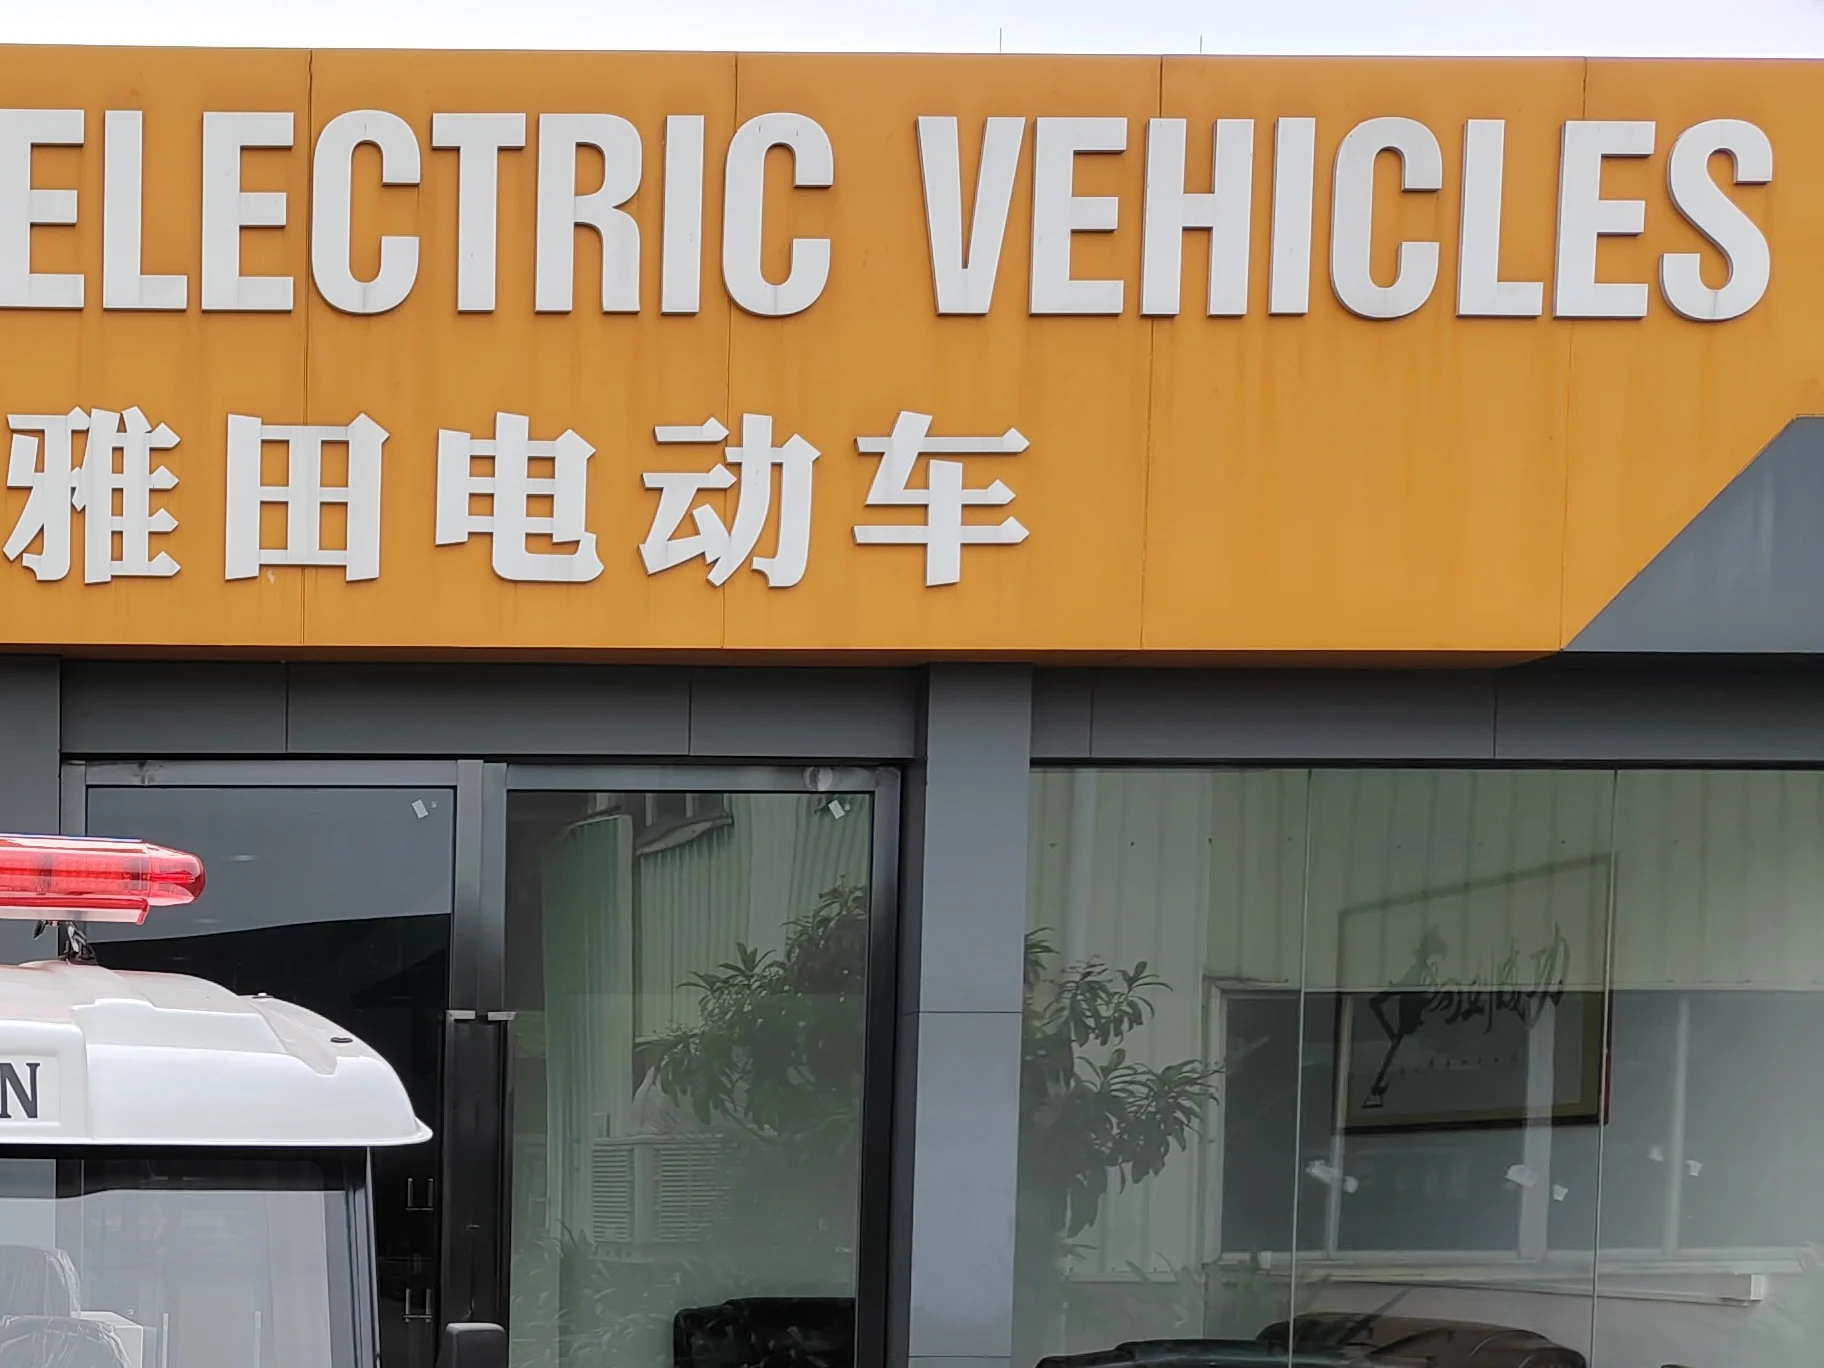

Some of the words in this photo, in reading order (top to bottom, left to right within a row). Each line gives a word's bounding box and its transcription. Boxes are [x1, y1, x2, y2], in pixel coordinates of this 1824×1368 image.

[917, 116, 1773, 320] VEHICLES
[3, 406, 1030, 587] 雅田电动车
